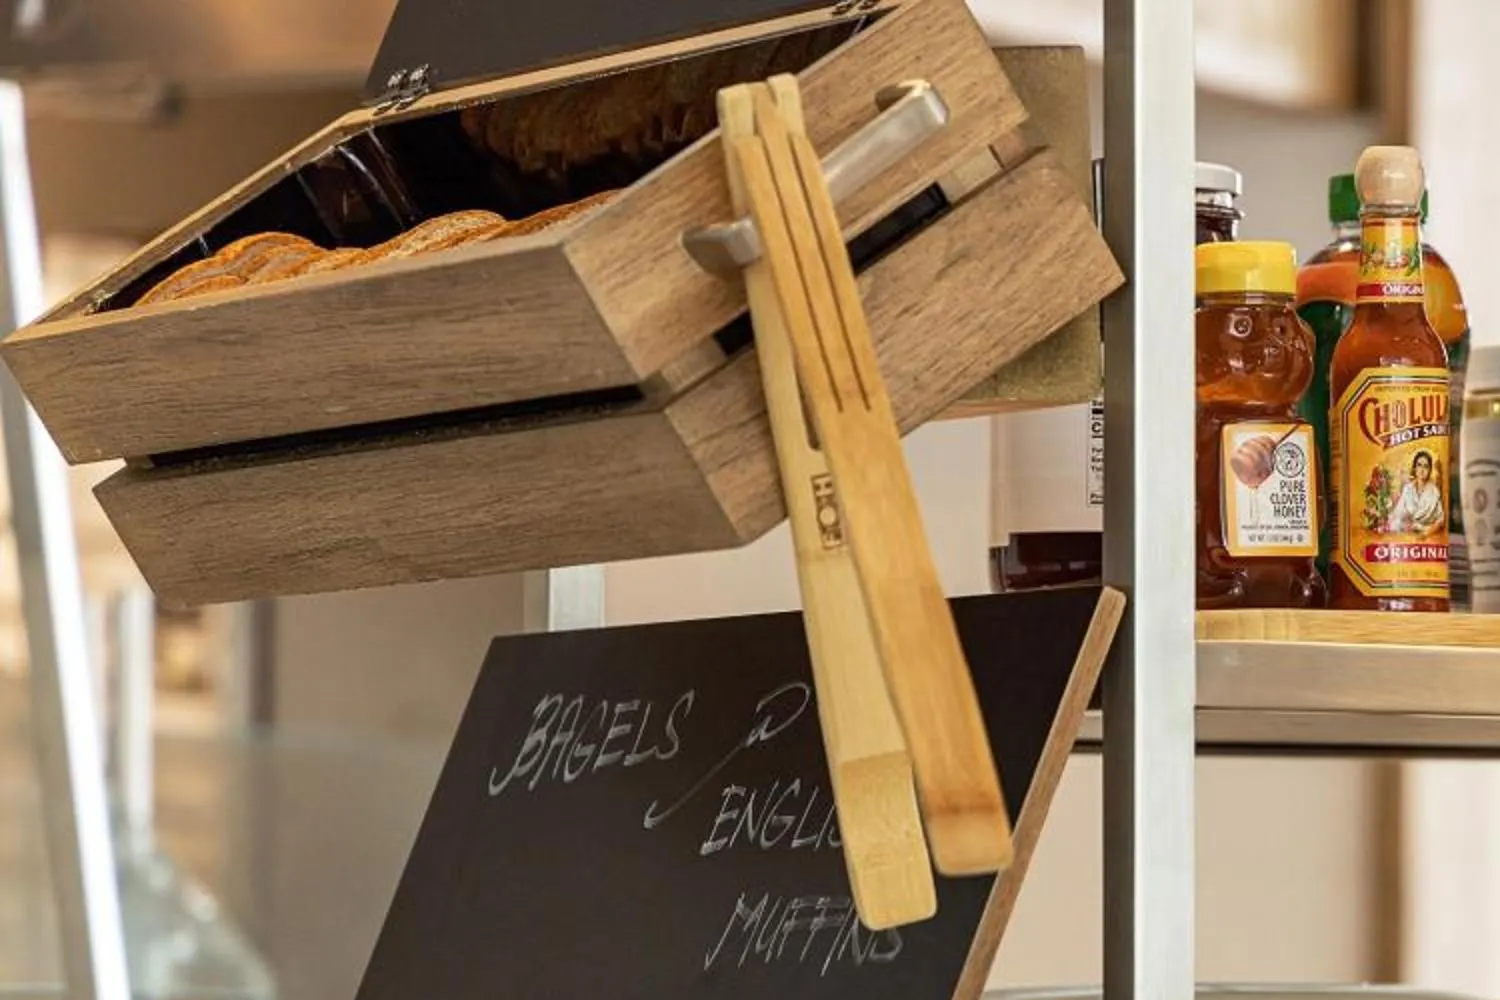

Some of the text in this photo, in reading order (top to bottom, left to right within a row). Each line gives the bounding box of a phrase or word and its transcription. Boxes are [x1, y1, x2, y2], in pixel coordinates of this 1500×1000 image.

[1390, 427, 1421, 446] HOT
[1280, 480, 1306, 493] PURE
[1269, 493, 1306, 505] CLOVER
[1273, 505, 1307, 518] HONEY
[488, 688, 695, 796] BAGELS
[700, 777, 843, 856] ENGLI
